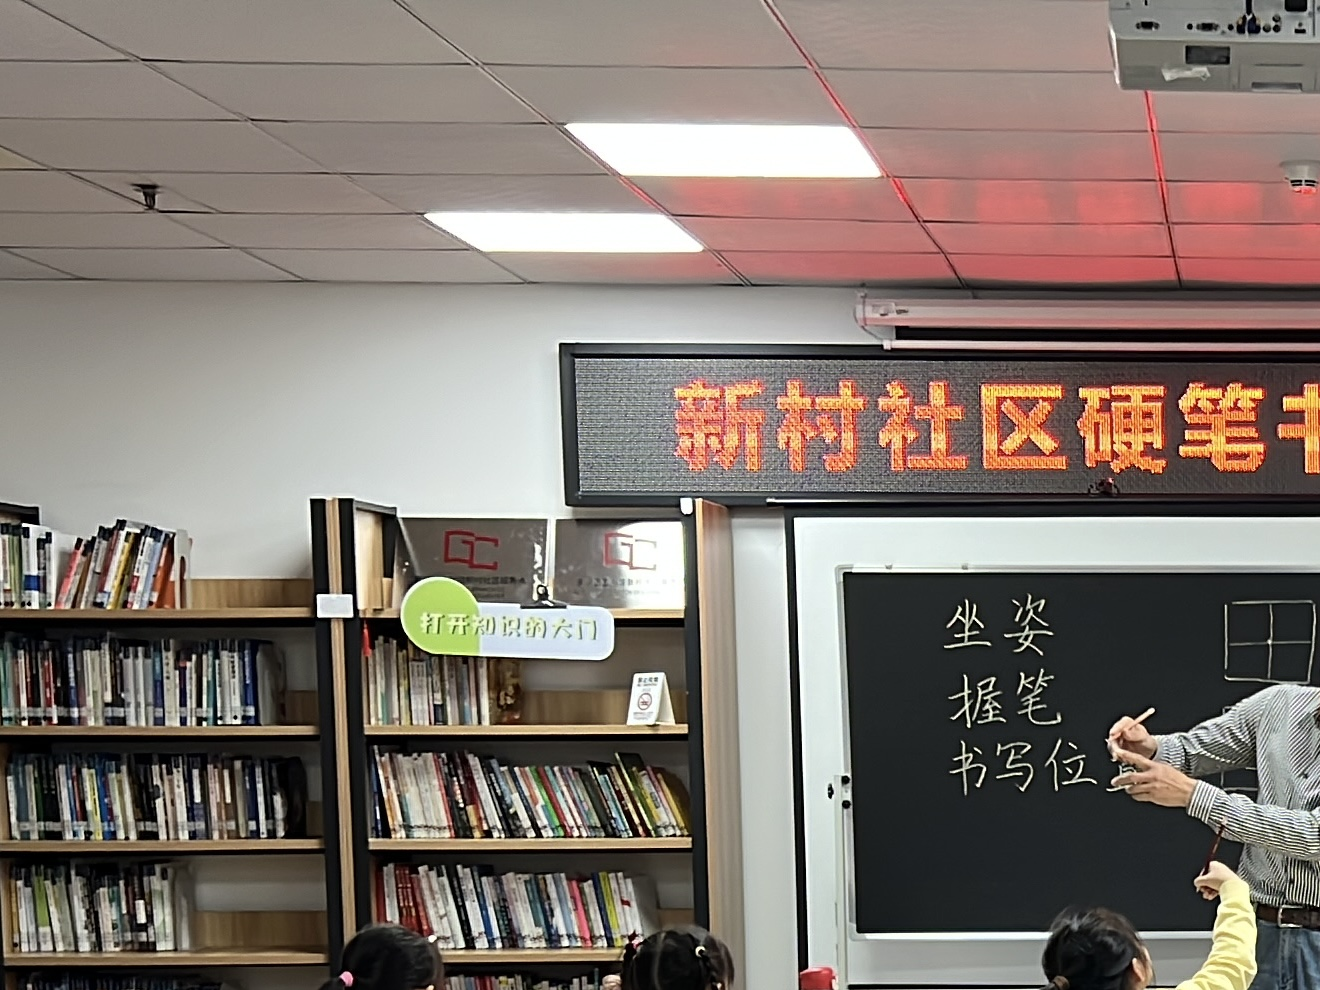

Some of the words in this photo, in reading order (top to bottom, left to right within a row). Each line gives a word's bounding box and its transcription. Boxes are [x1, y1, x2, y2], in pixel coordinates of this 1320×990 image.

[420, 612, 597, 640] 打开知识的大门
[943, 593, 1054, 656] 坐姿
[948, 668, 1062, 728] 握笔
